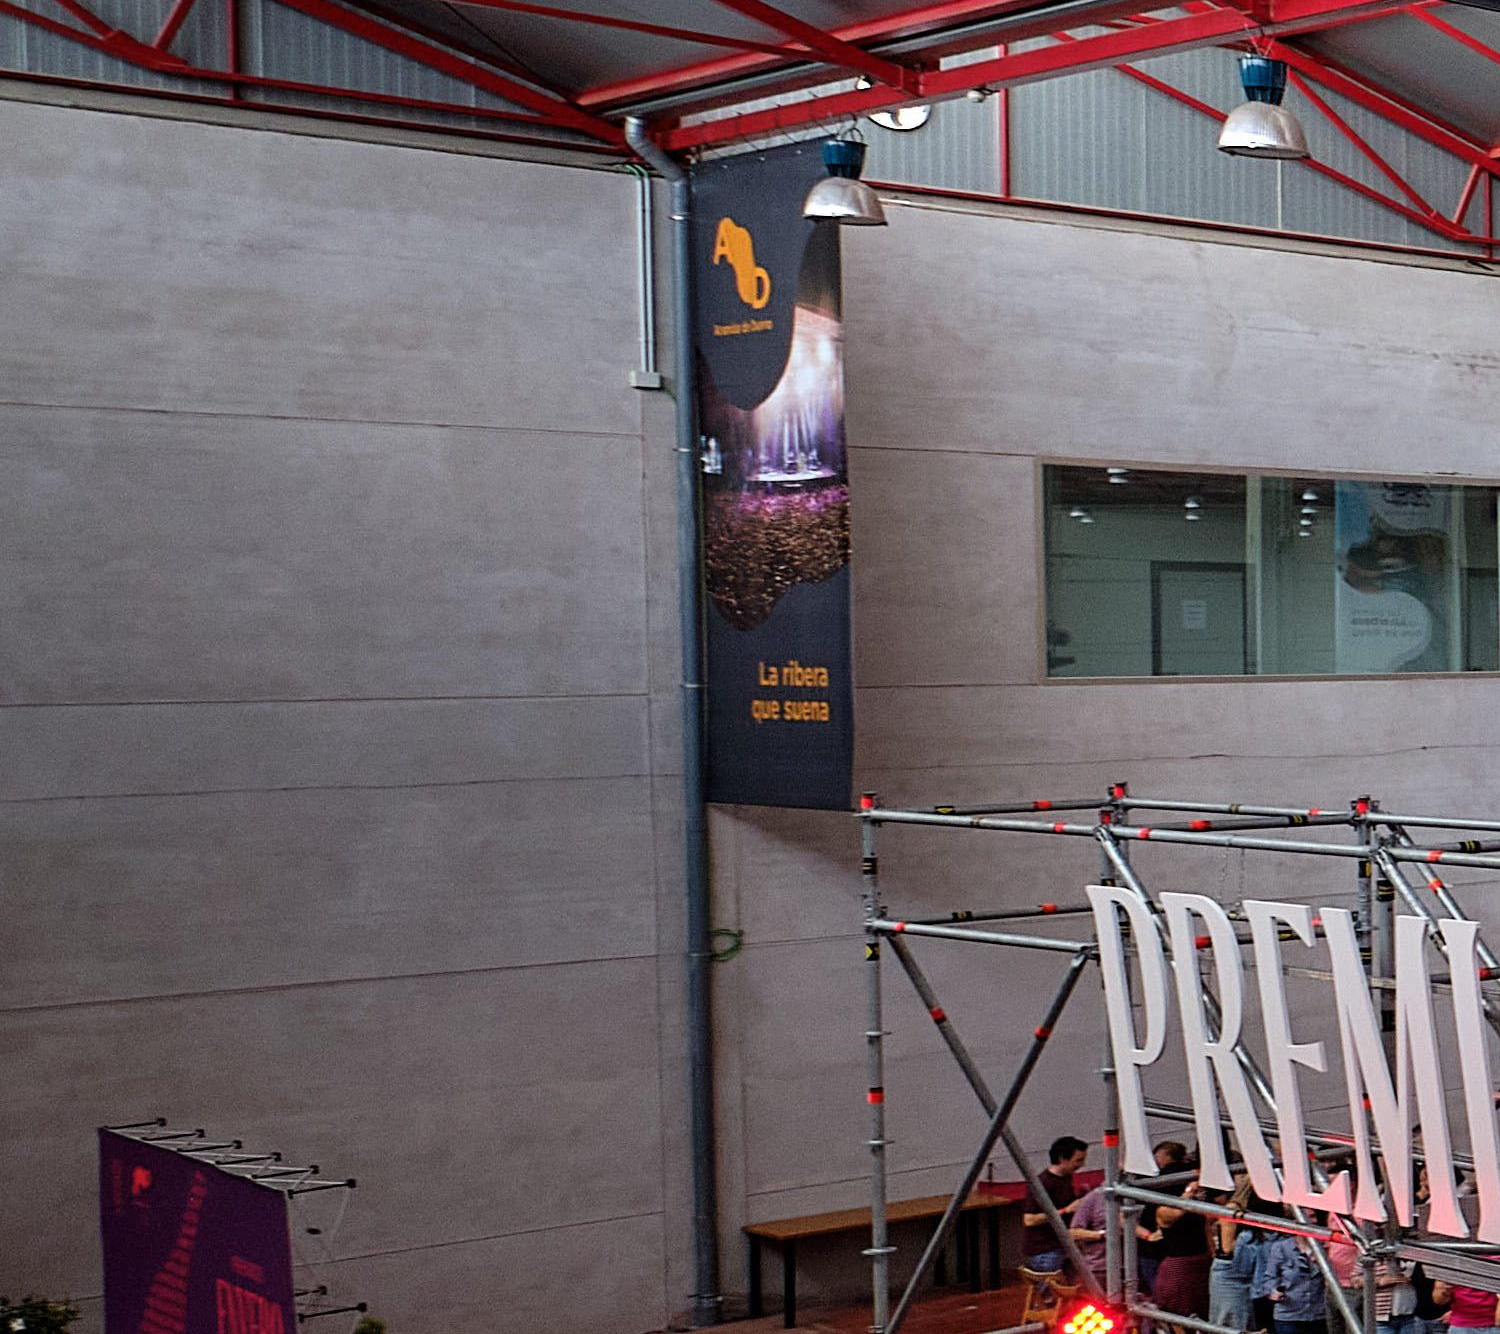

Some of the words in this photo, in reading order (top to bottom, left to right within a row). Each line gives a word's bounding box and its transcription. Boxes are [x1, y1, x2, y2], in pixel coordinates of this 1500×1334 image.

[758, 661, 779, 686] La
[782, 660, 829, 687] ribera
[751, 699, 780, 724] que
[783, 700, 830, 722] suena
